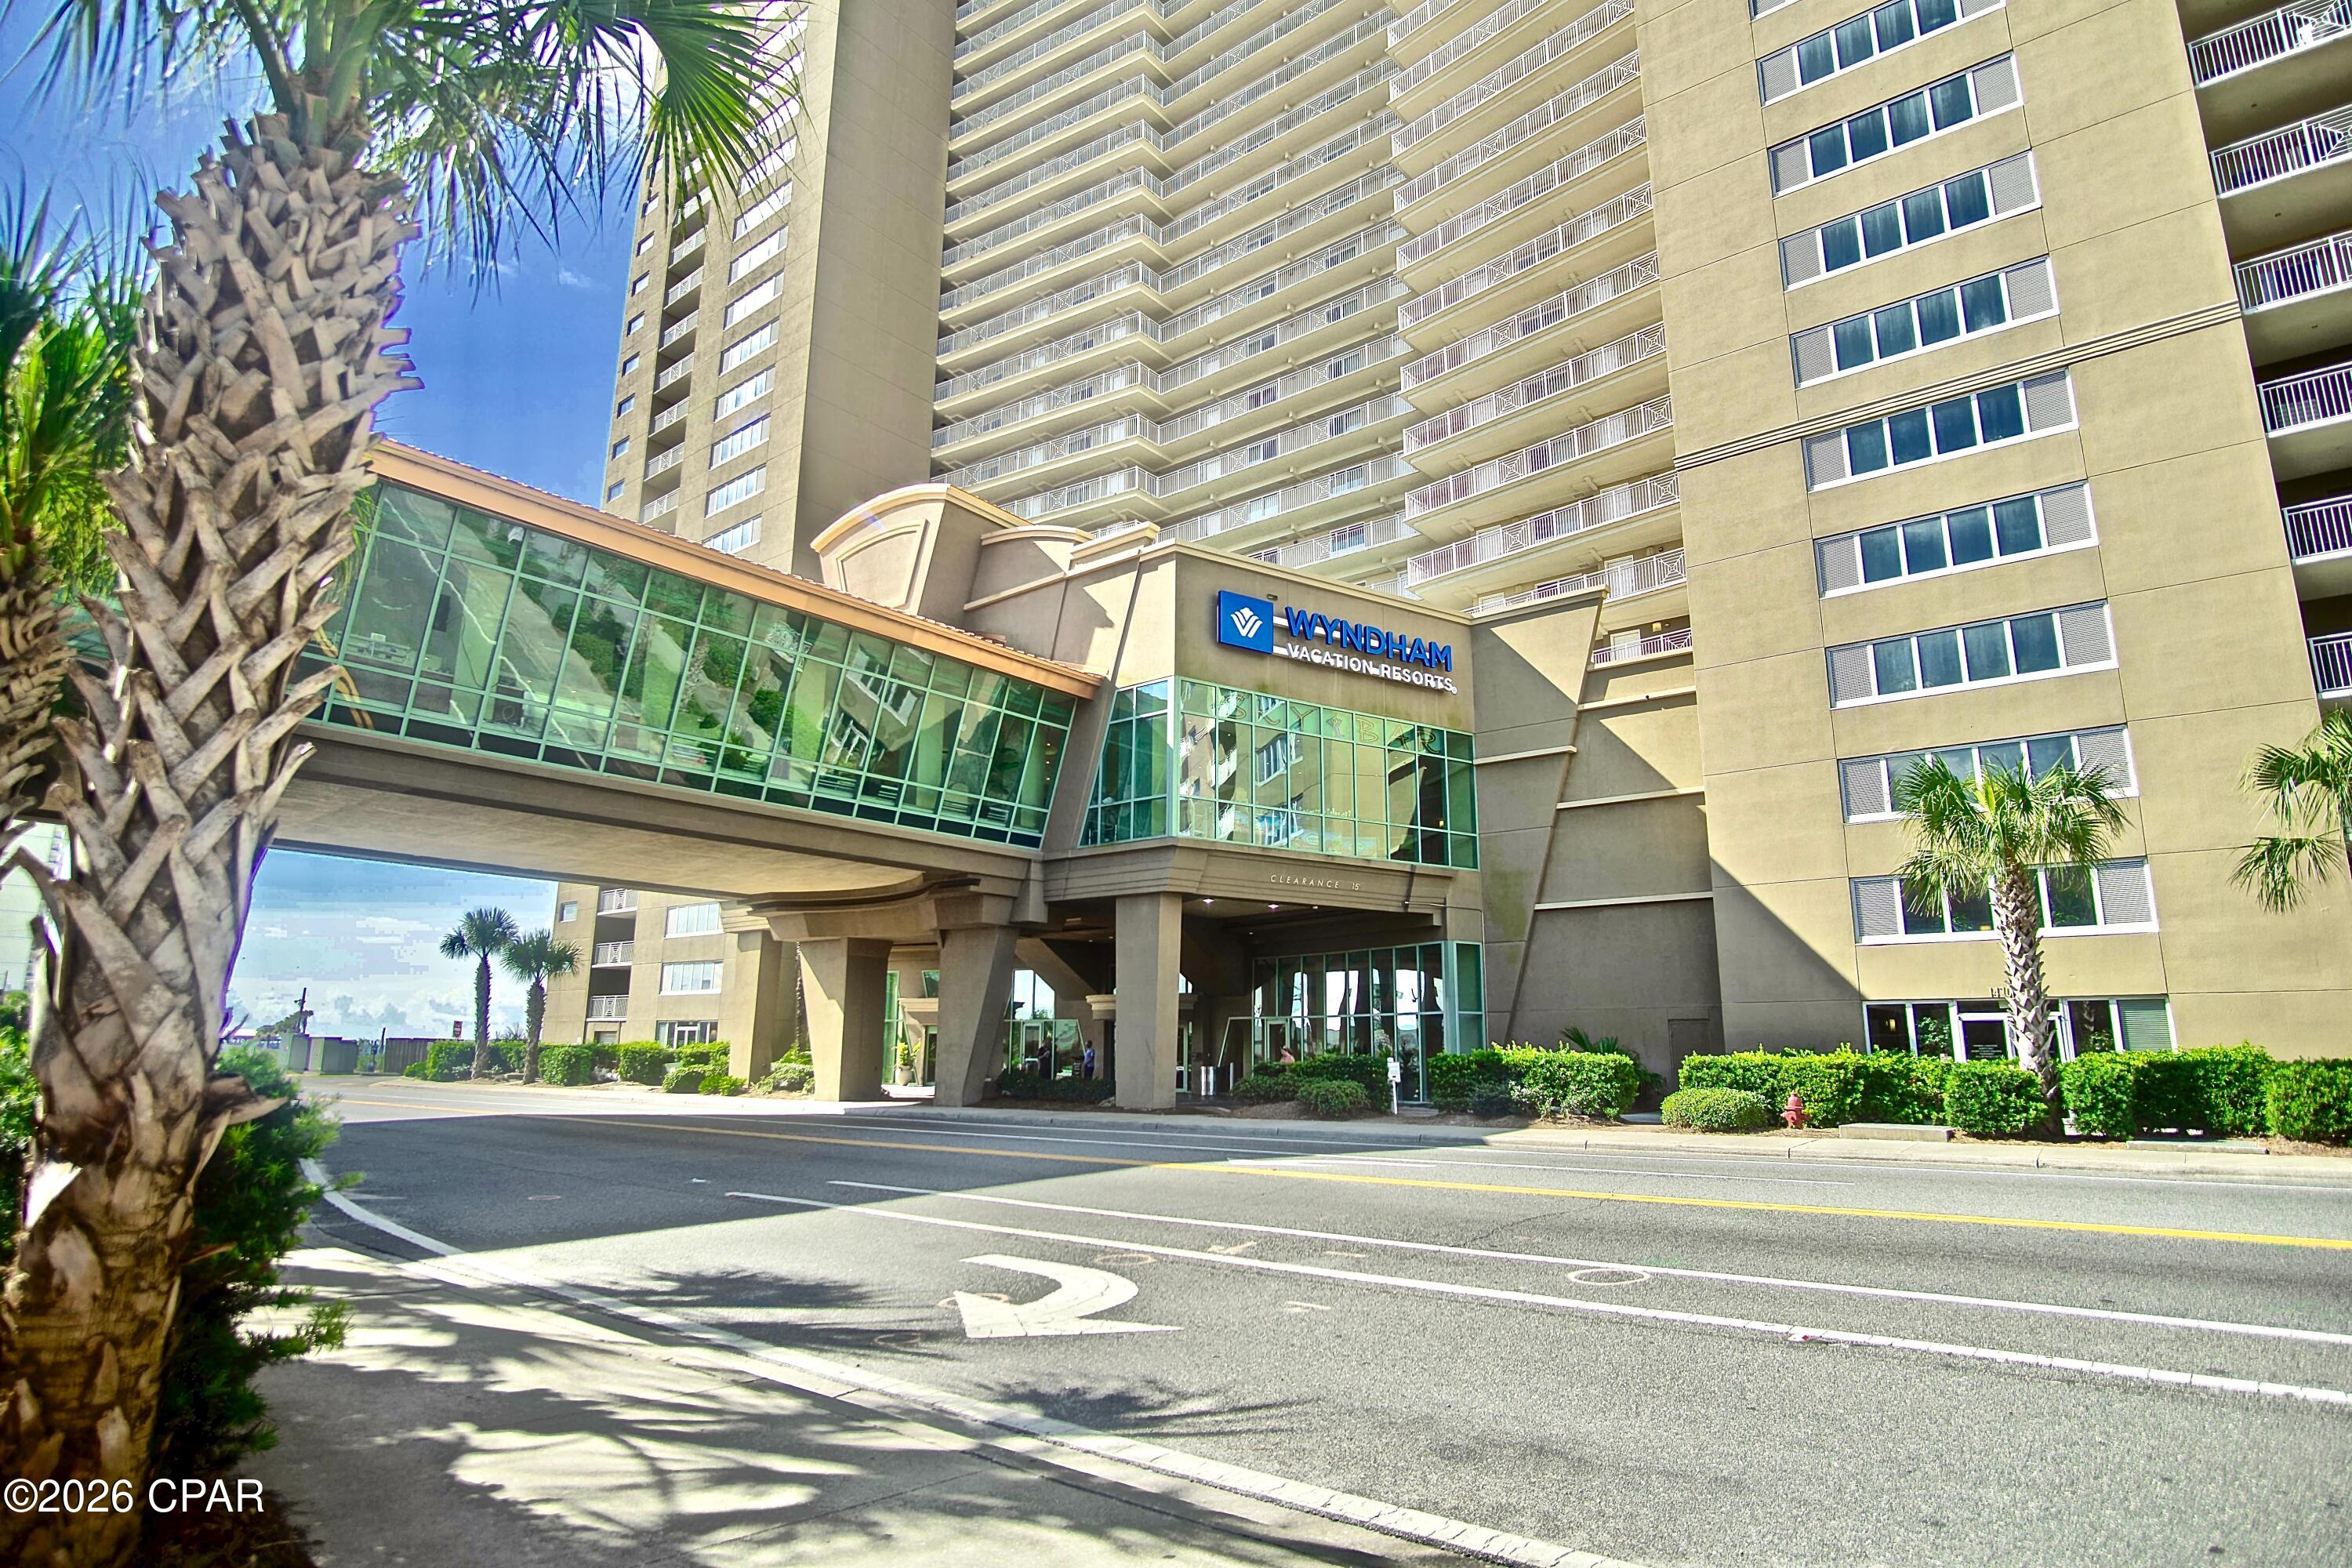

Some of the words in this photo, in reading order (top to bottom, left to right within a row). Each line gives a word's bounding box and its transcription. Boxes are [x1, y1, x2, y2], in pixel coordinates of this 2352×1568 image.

[1285, 606, 1452, 672] WYNDHAM
[1287, 642, 1373, 675] VACATION
[1355, 717, 1441, 753] BAR
[1270, 874, 1339, 888] CLEARANCE
